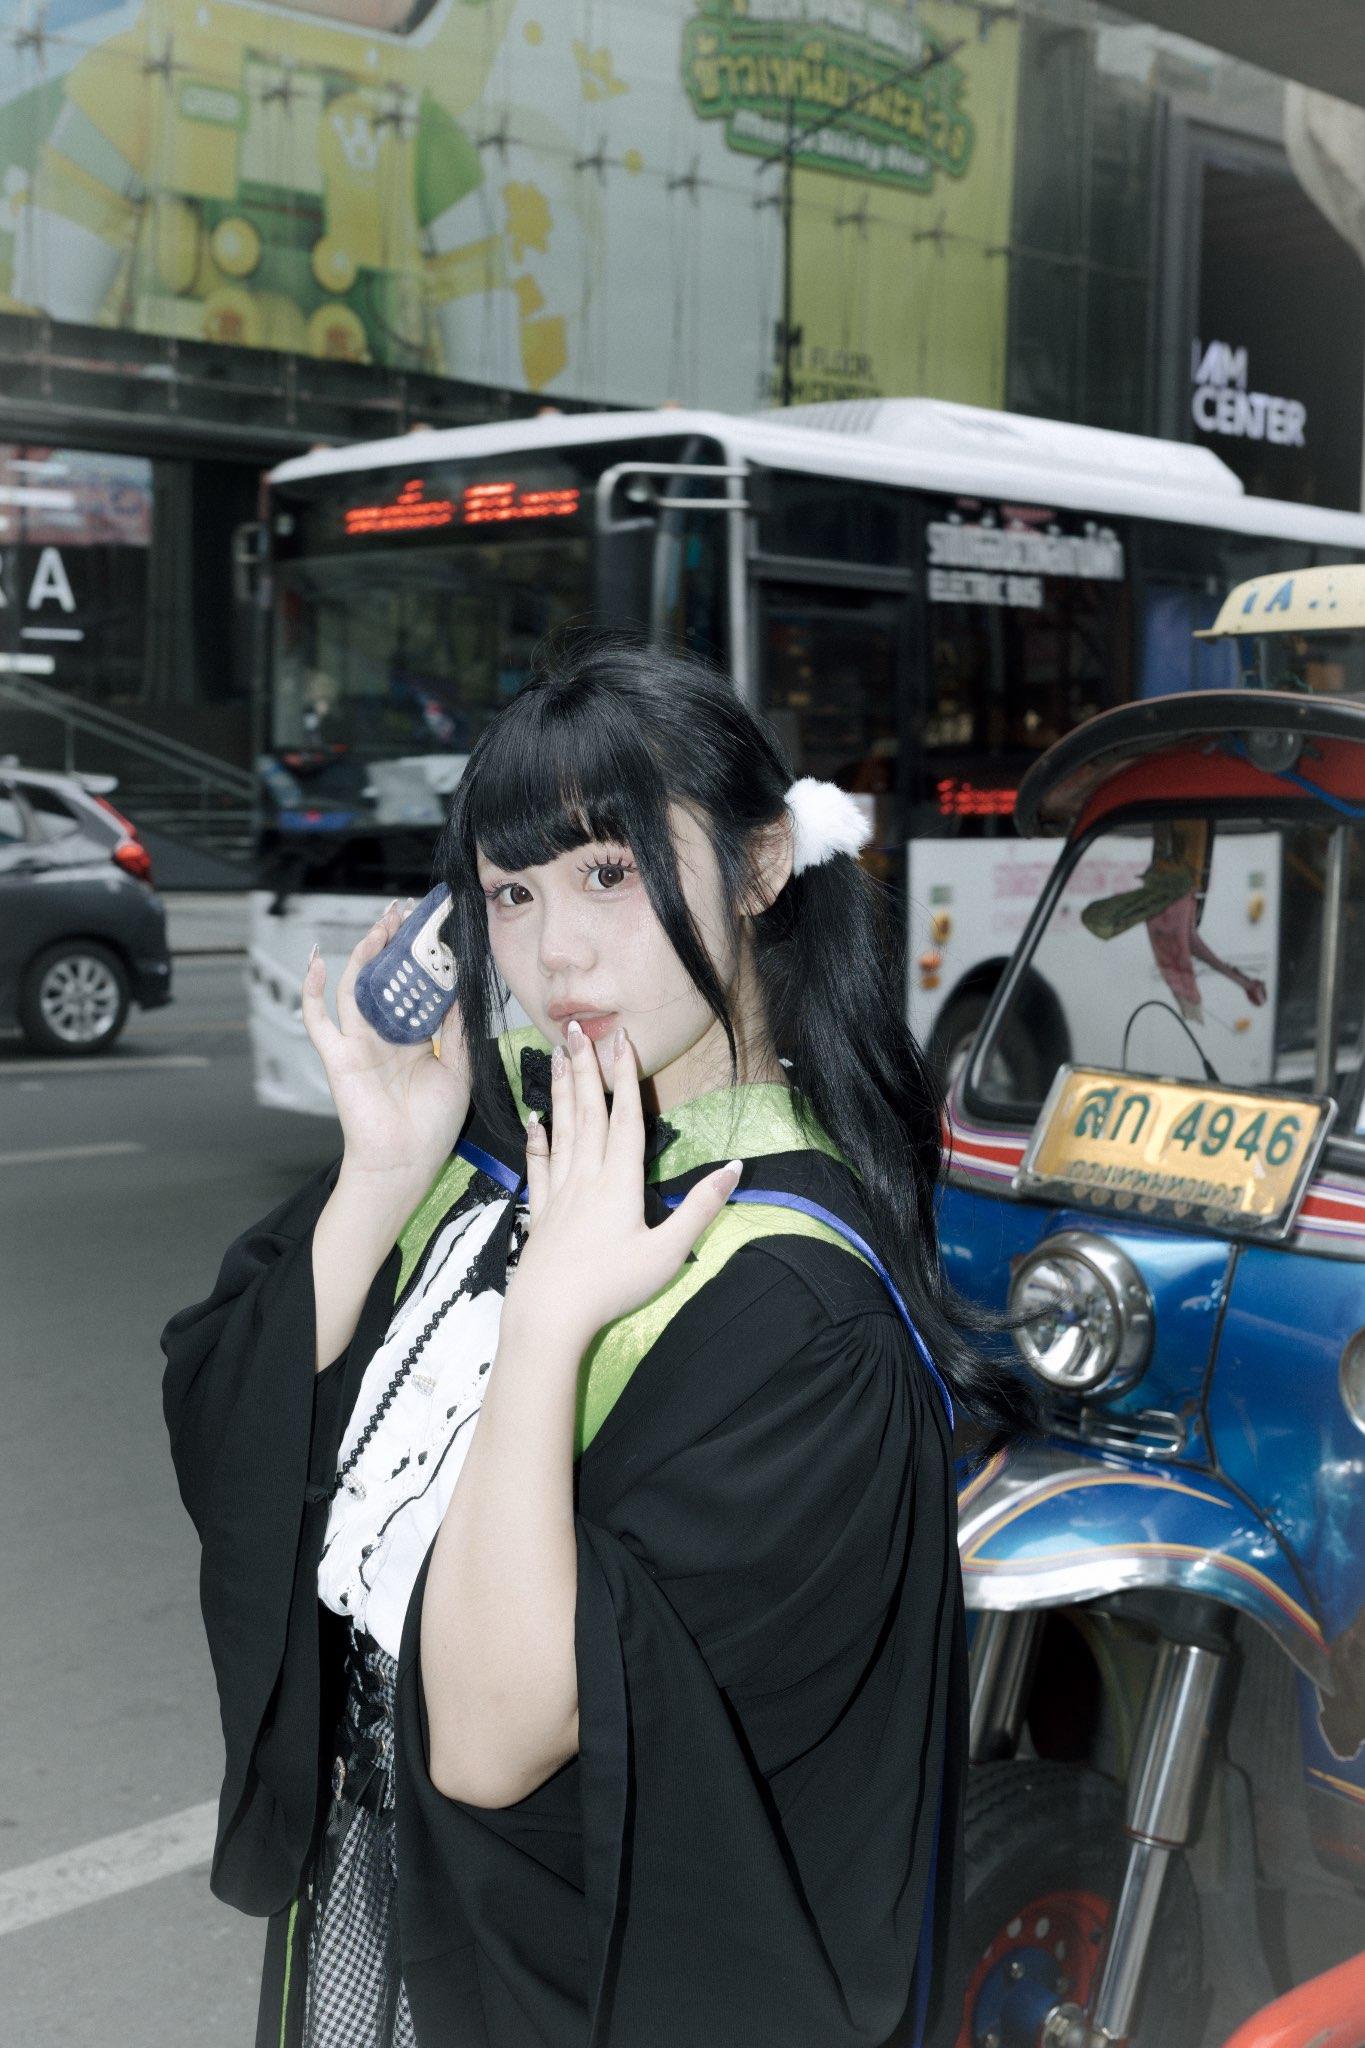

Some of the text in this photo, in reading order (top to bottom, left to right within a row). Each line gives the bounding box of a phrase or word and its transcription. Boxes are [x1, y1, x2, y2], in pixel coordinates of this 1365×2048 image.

[1191, 384, 1307, 446] CENTER
[1073, 1086, 1302, 1167] สก 4946
